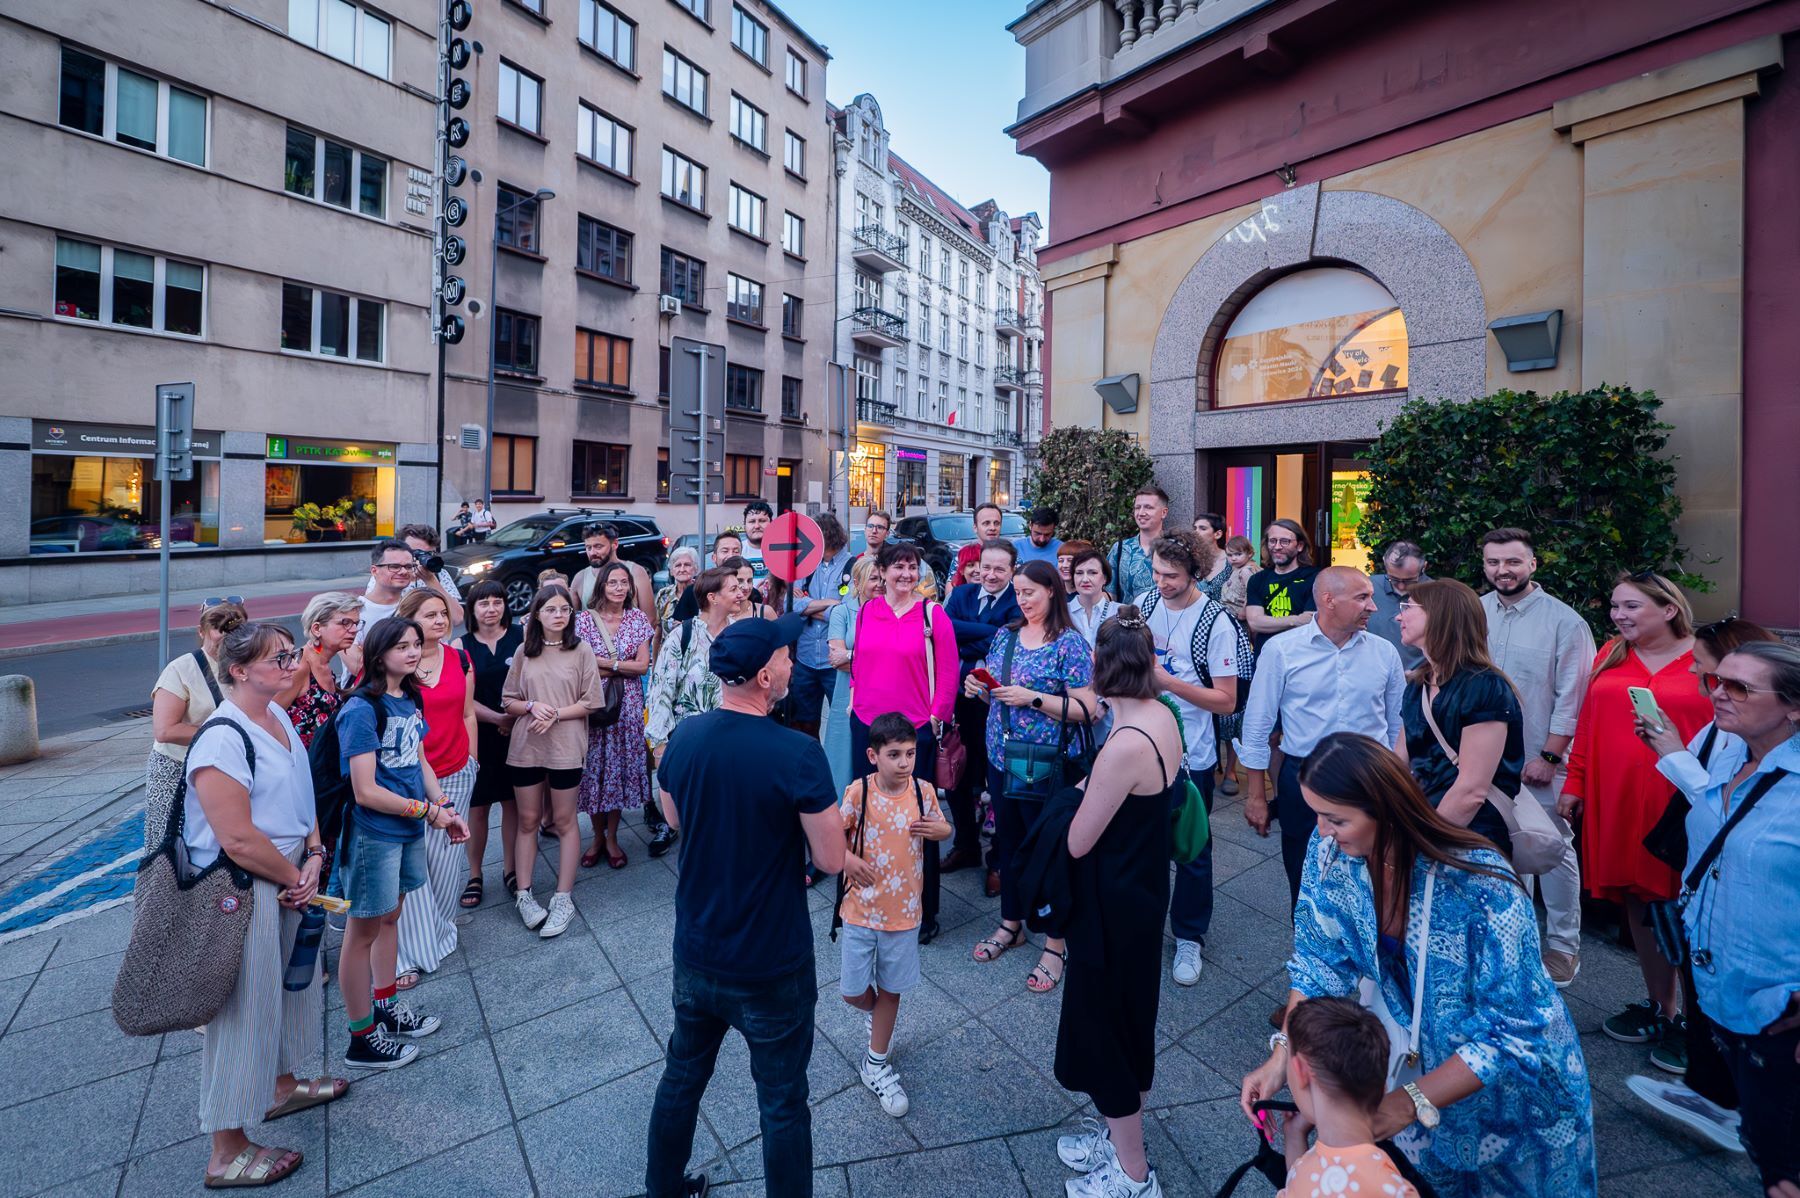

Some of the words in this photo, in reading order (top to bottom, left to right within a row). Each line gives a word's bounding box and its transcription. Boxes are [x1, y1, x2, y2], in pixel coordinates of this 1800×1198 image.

[80, 434, 118, 443] Centrum
[119, 436, 156, 446] Informac
[295, 445, 321, 456] PTTK
